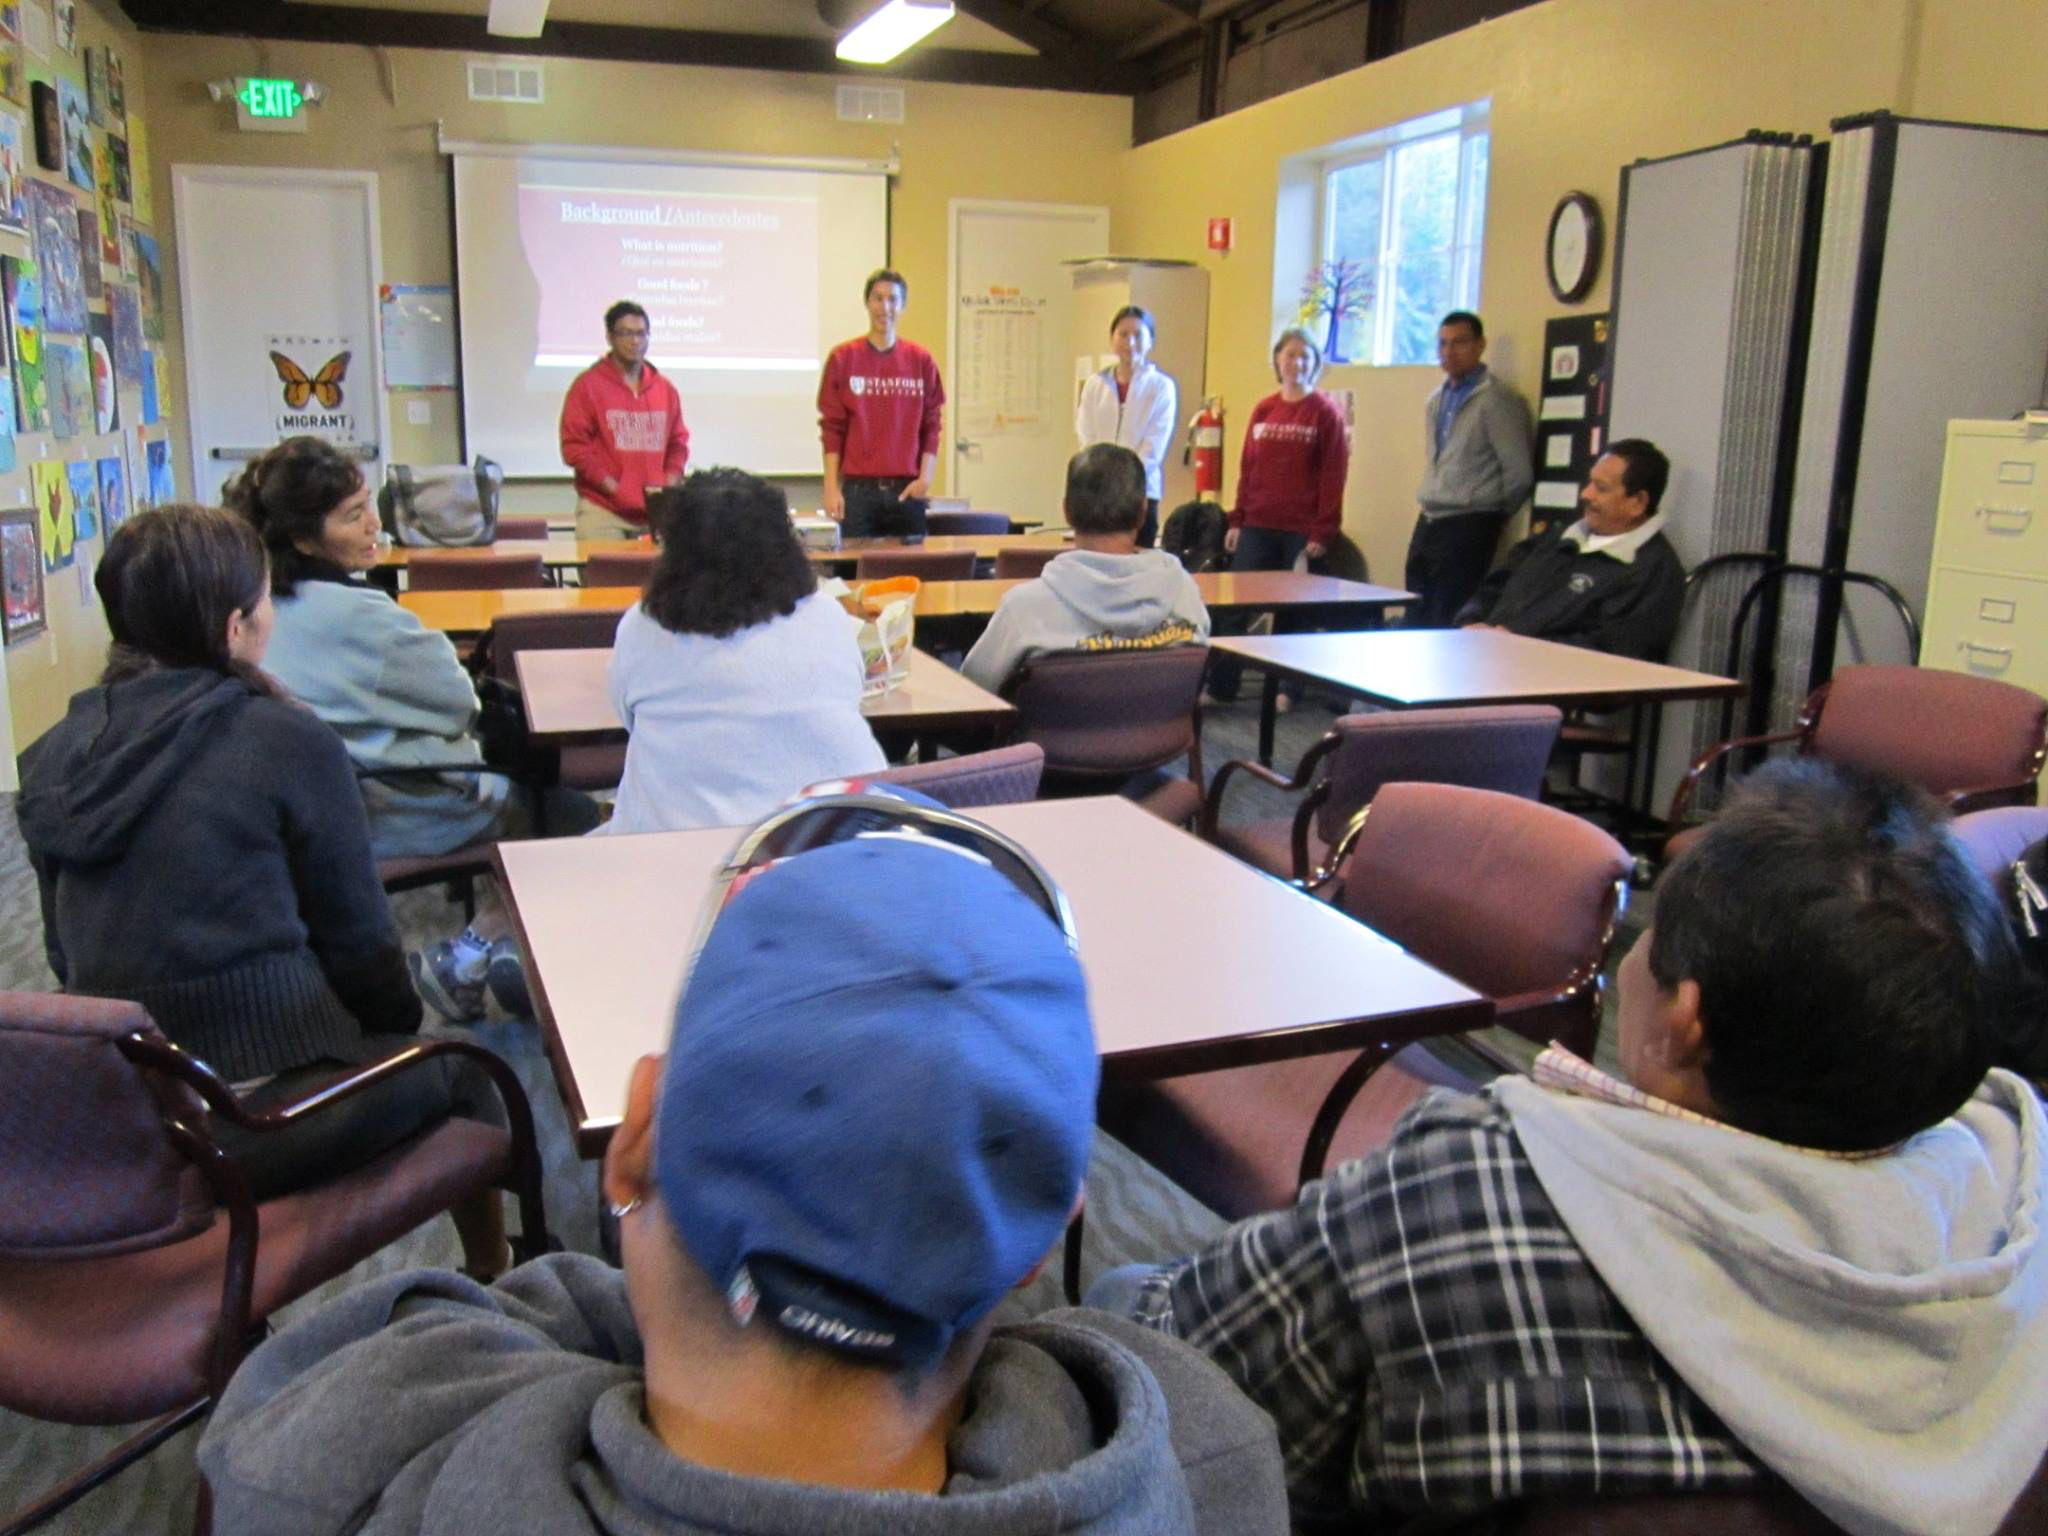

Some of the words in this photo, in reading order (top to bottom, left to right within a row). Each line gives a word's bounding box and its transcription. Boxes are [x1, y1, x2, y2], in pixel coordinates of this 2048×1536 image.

[248, 79, 294, 116] EXIT
[560, 200, 660, 224] Background
[621, 238, 652, 252] What
[654, 239, 665, 252] is
[666, 240, 724, 253] nutrition?
[637, 277, 667, 290] Good
[866, 376, 925, 388] STANFORD
